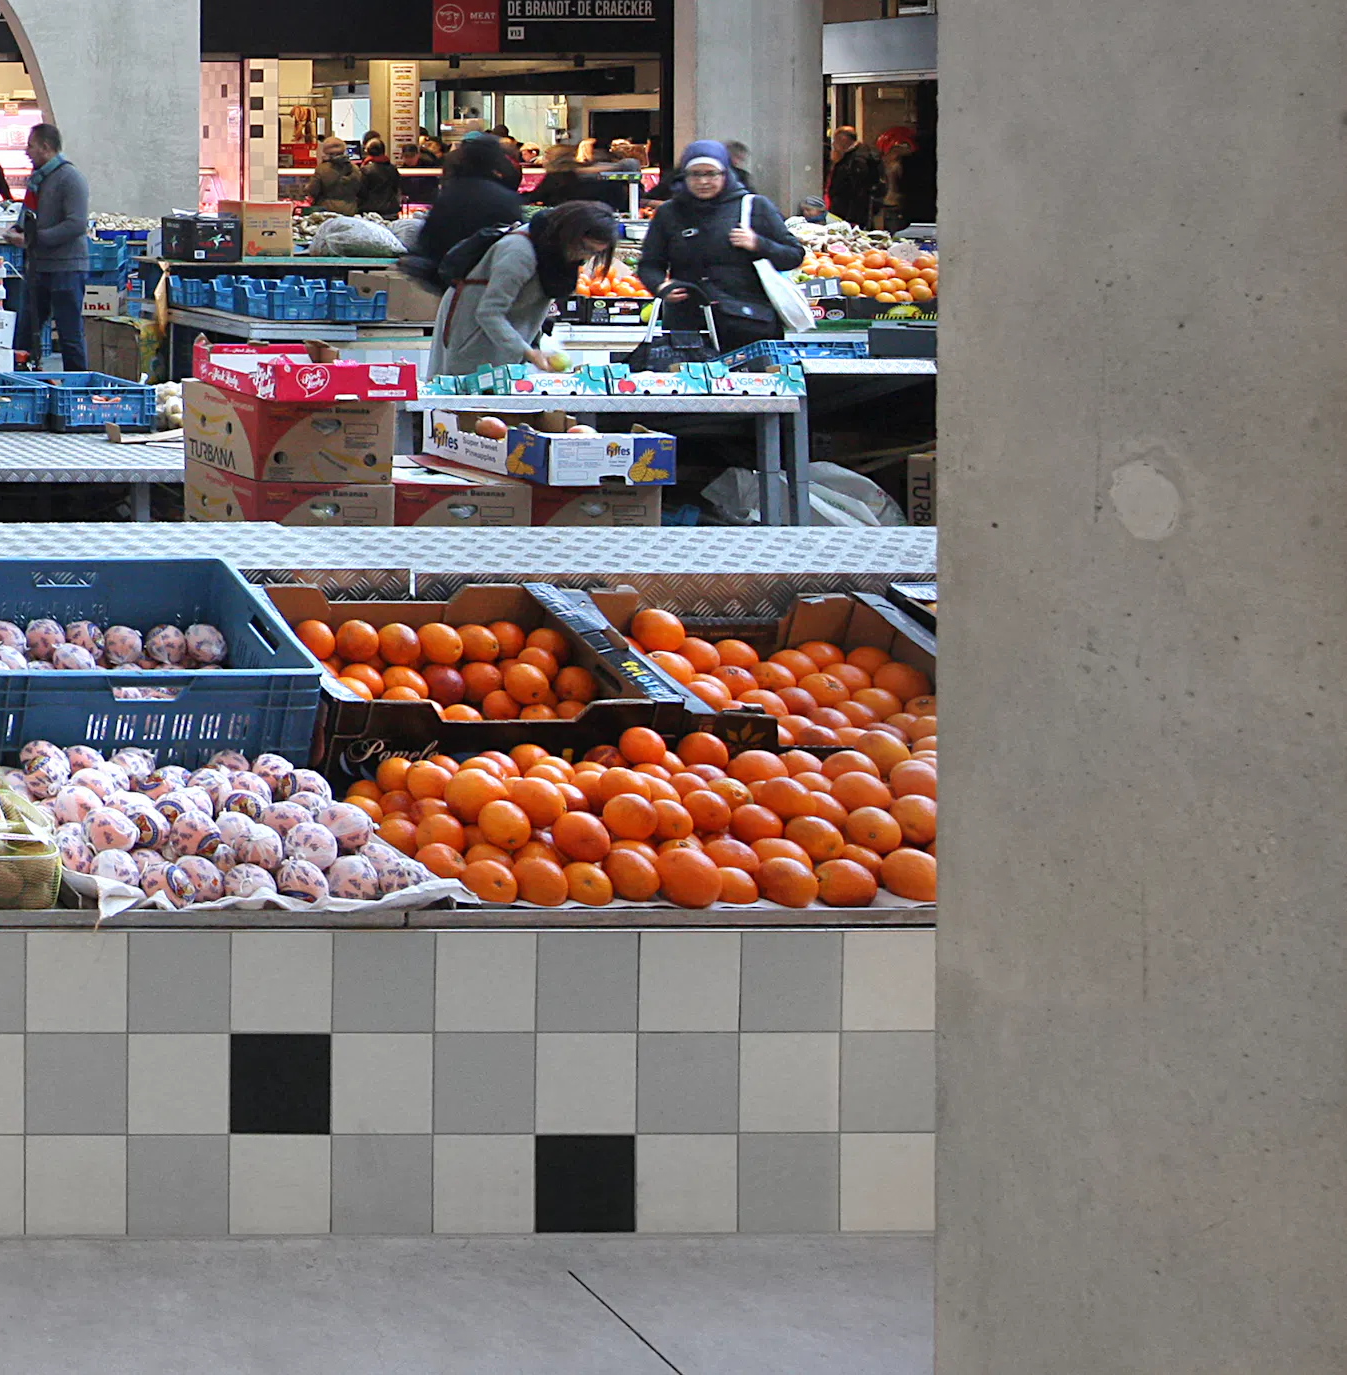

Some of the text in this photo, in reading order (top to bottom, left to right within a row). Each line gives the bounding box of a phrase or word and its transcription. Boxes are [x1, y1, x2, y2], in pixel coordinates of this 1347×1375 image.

[508, 0, 521, 16] DE
[595, 0, 652, 16] CRAECKER
[470, 12, 495, 20] MEAT
[509, 29, 521, 38] V13
[301, 369, 323, 384] Pink
[306, 377, 326, 390] Lady
[335, 407, 371, 415] Bananas
[462, 436, 479, 448] Super
[189, 438, 237, 470] TURBANA
[333, 490, 369, 498] Bananas
[912, 472, 933, 525] TURB
[346, 738, 439, 763] Pomelo
